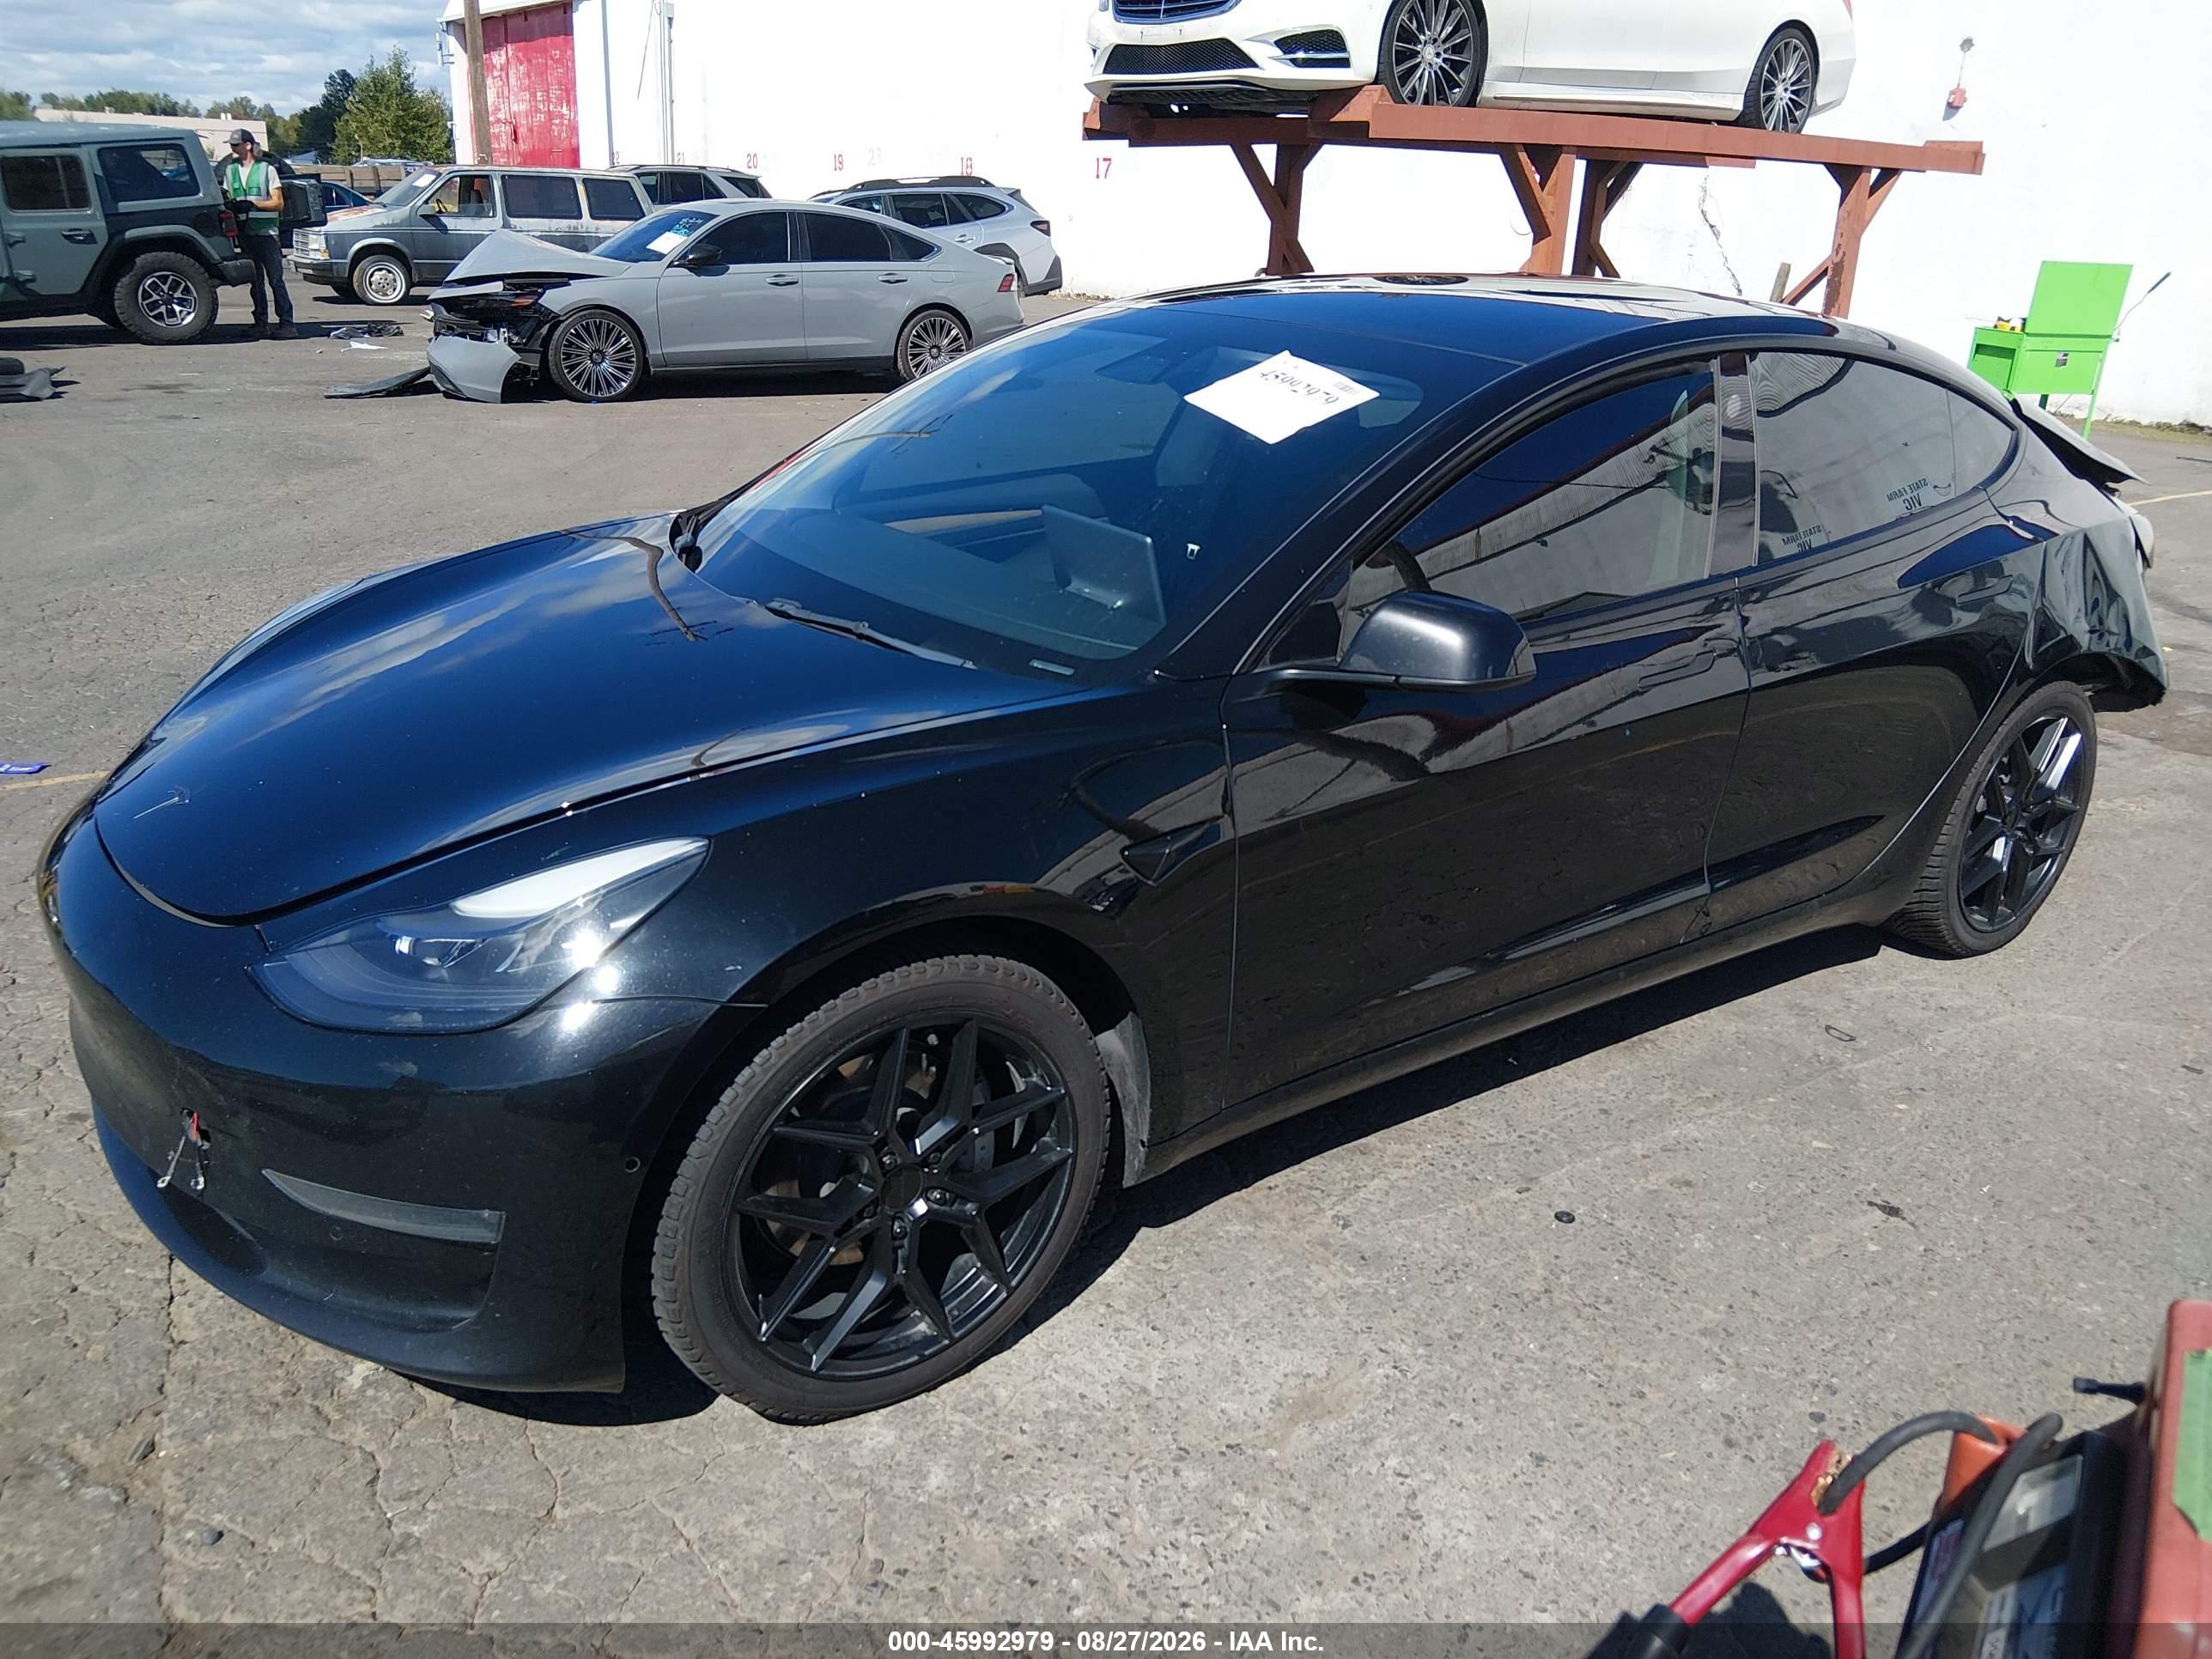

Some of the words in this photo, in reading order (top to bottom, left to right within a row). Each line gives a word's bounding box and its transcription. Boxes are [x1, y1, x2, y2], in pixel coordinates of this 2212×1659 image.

[746, 153, 758, 169] 20
[833, 154, 844, 171] 19
[960, 156, 974, 177] 18
[1095, 157, 1113, 179] 17
